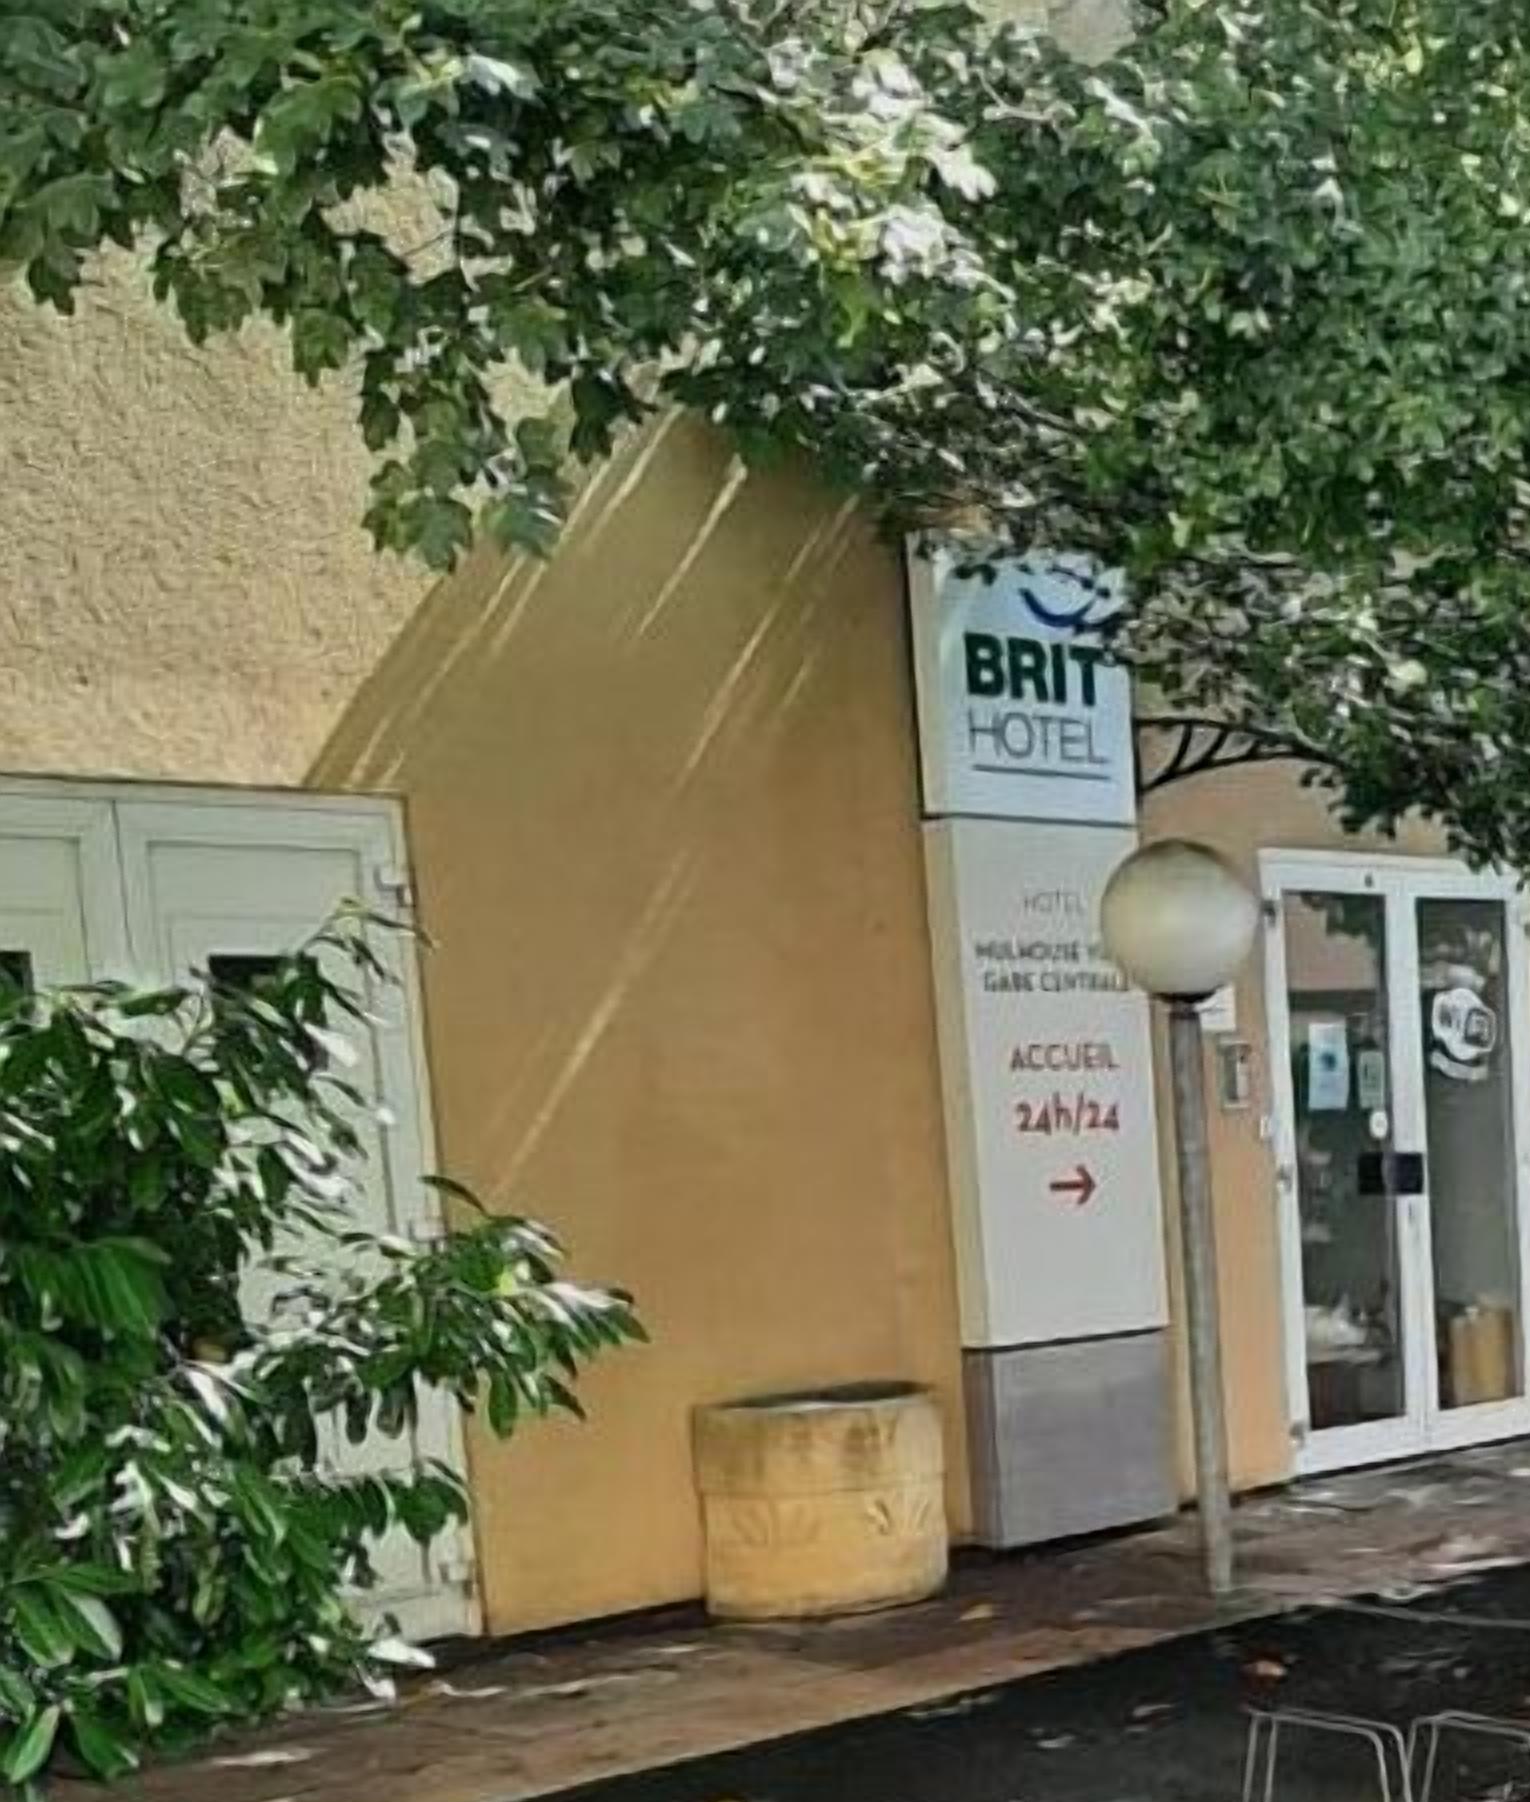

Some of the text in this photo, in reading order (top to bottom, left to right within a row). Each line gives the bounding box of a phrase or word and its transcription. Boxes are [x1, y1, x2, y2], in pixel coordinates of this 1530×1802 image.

[964, 631, 1102, 707] BRIT
[967, 707, 1111, 764] HOTEL
[1010, 1043, 1120, 1071] ACCUEIL
[1016, 1091, 1120, 1136] 24h/24
